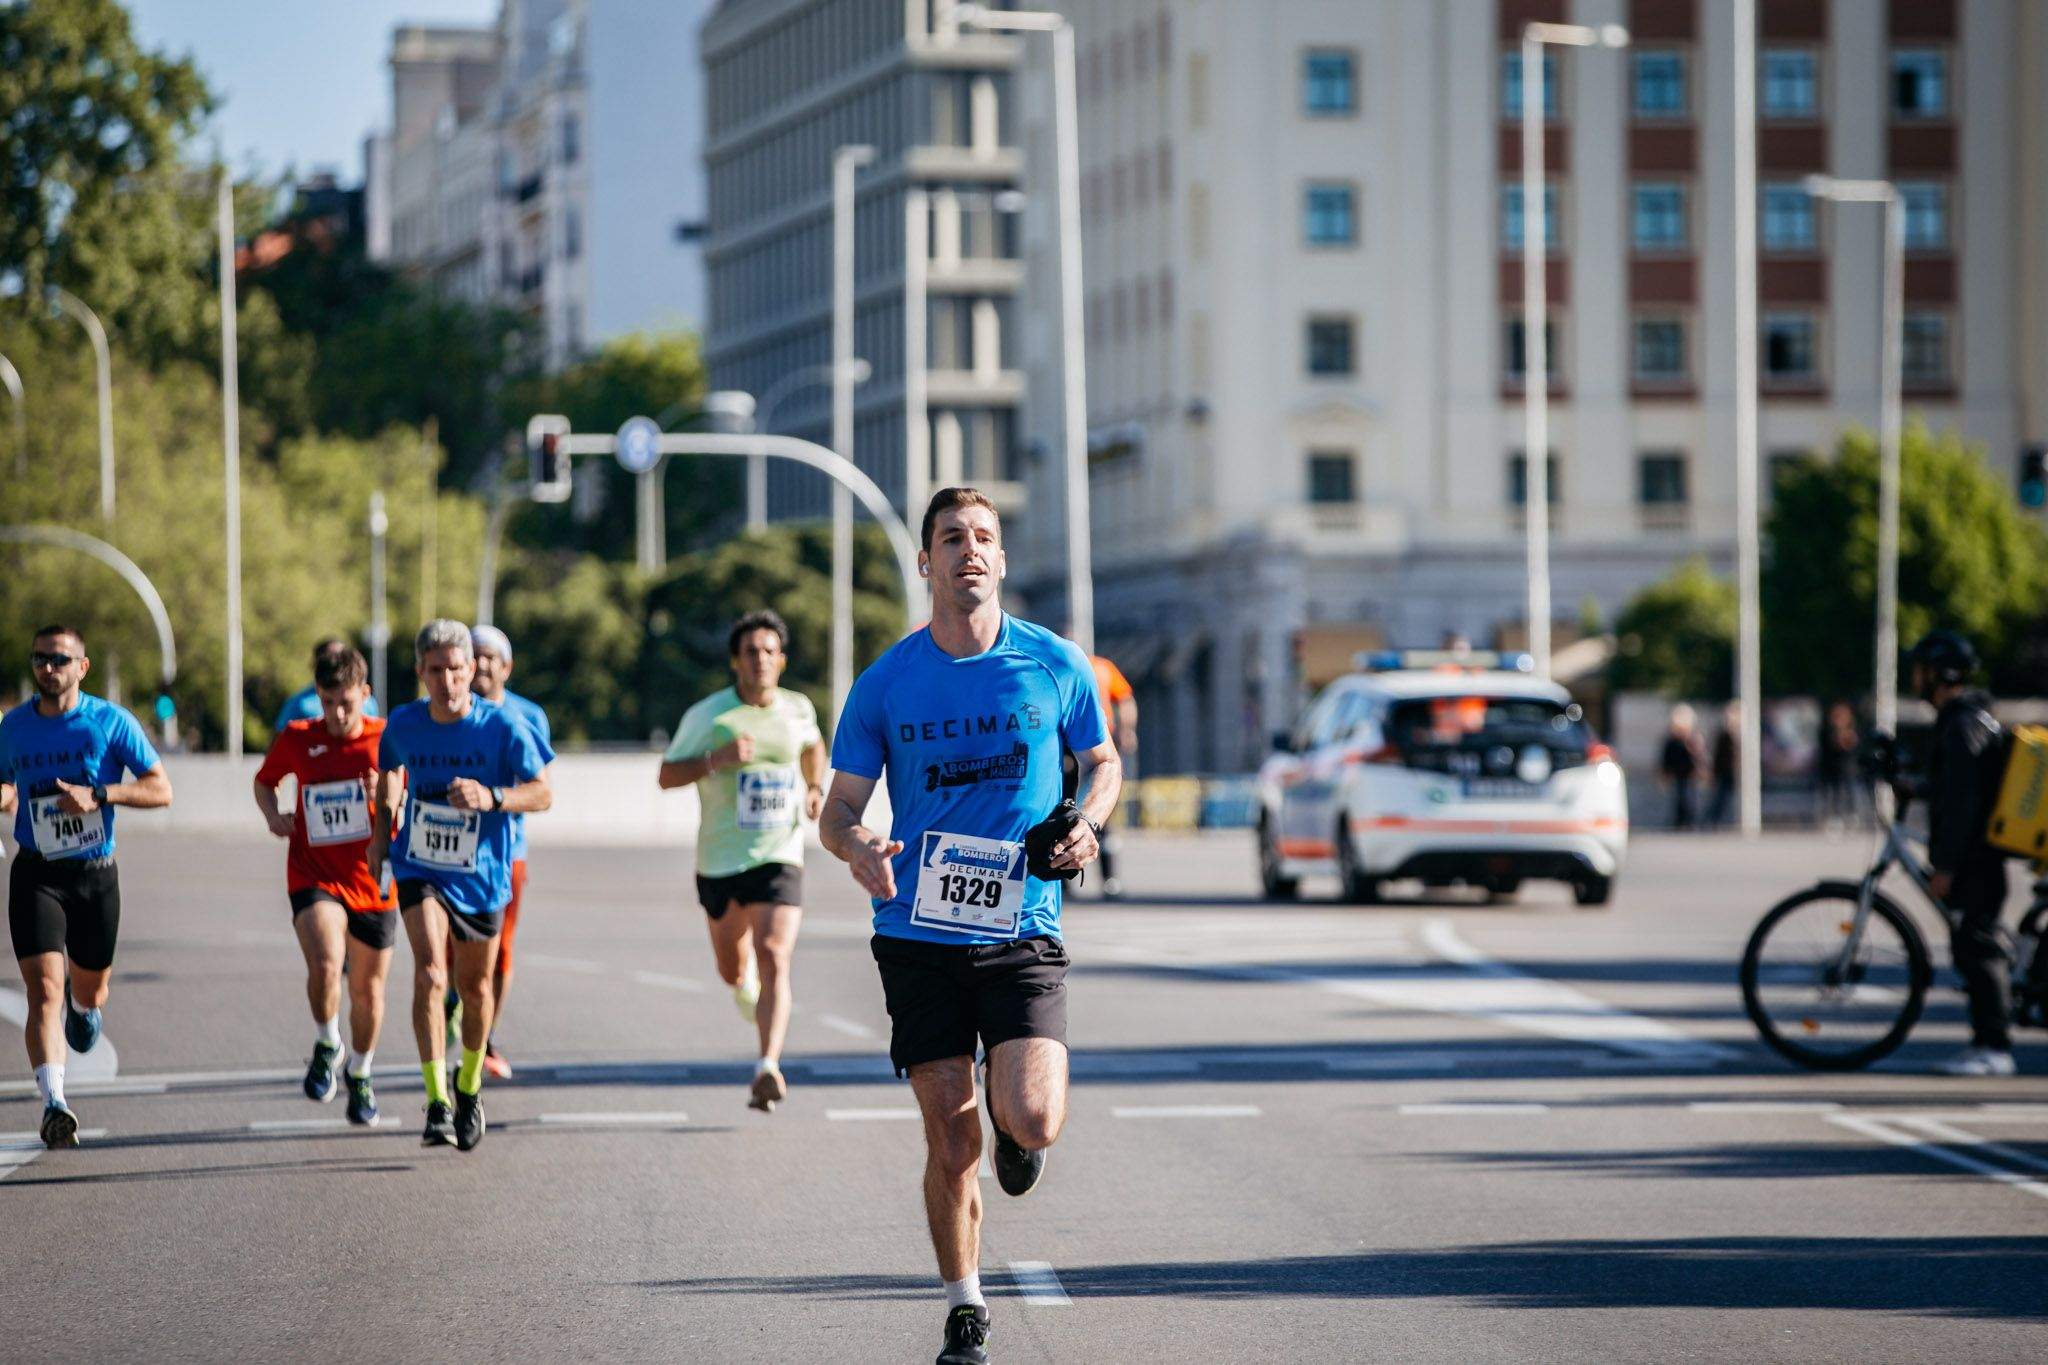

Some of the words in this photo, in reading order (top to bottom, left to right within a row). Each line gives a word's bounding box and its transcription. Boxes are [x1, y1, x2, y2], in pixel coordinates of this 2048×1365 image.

[900, 710, 1042, 743] DECIMAS
[949, 754, 1026, 774] BOMBEROS
[322, 805, 349, 826] 571
[54, 816, 85, 839] 740
[426, 830, 460, 852] 1311
[957, 849, 1008, 863] BOMBEROS
[949, 863, 1004, 879] DECIMAS
[940, 873, 1003, 909] 1329
